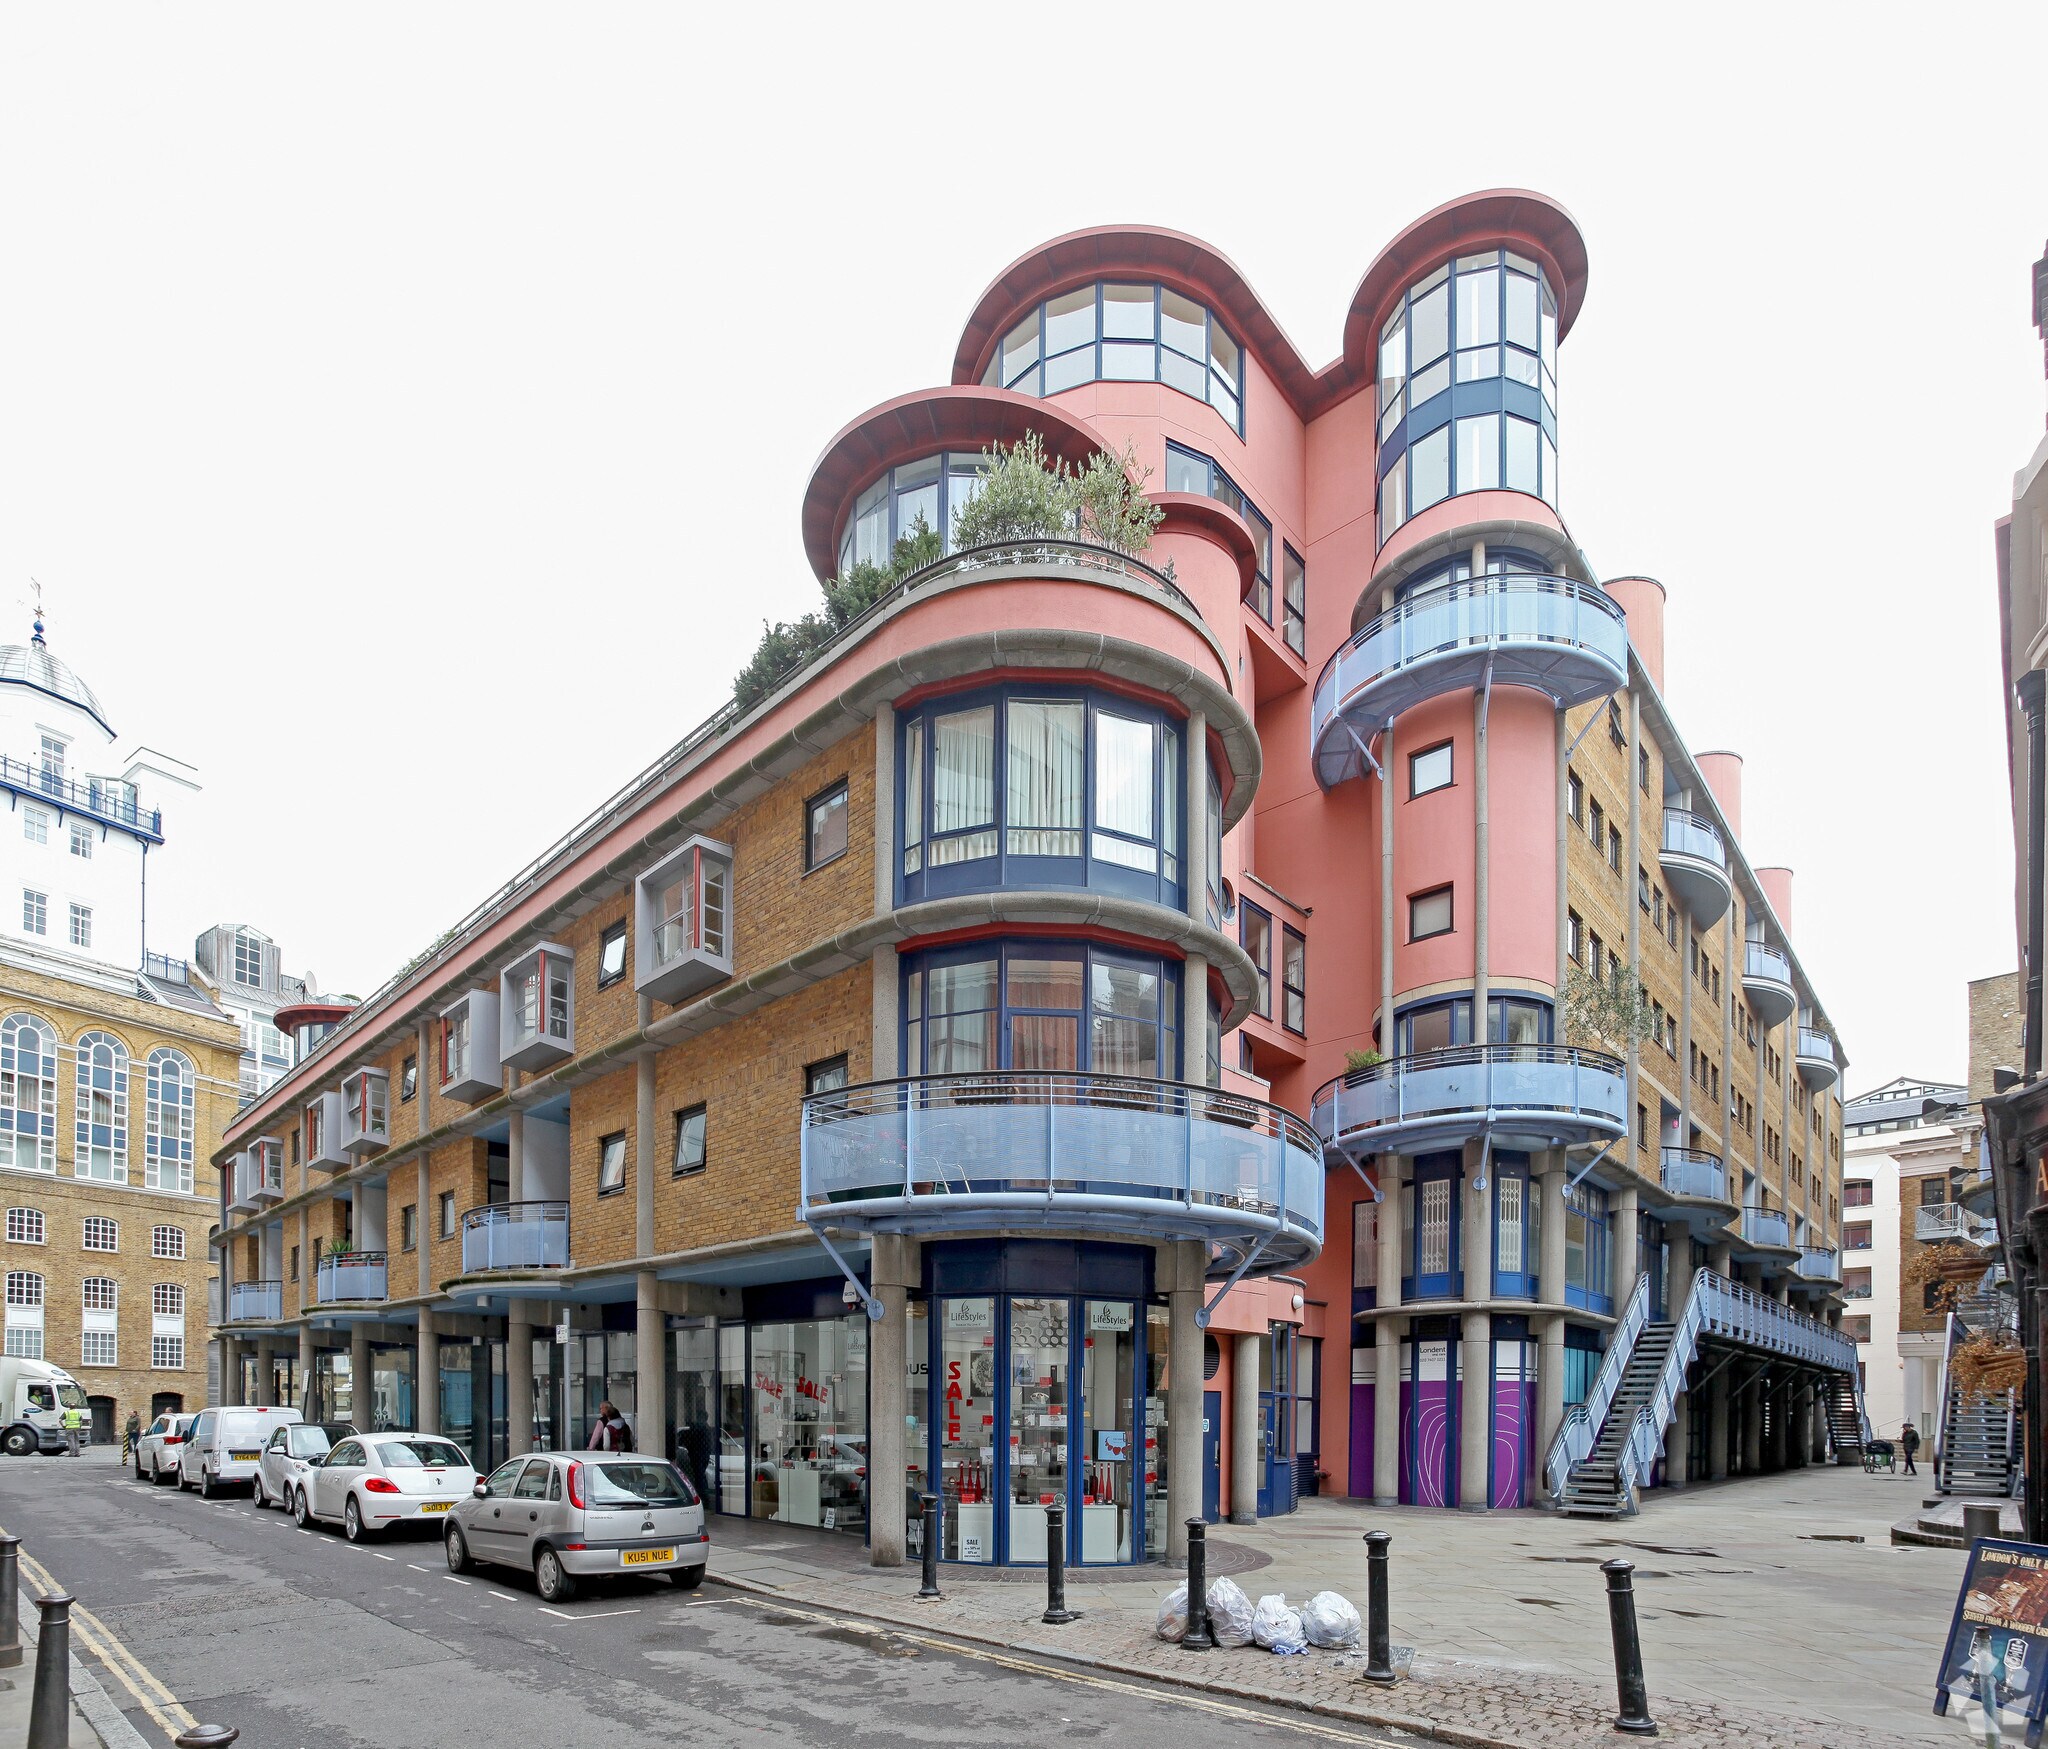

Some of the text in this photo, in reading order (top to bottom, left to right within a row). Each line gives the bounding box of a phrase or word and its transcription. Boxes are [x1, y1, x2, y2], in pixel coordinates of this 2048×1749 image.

[950, 1312, 987, 1322] LifeStyles
[1092, 1314, 1127, 1326] LifeStyles
[755, 1371, 783, 1400] SALE
[796, 1376, 828, 1404] SALE
[946, 1361, 963, 1441] SALE
[628, 1550, 669, 1562] KU51 NUE
[1981, 1550, 2019, 1565] LONDON'S
[2020, 1556, 2041, 1568] ONLY
[1963, 1610, 1985, 1622] SERVED
[2036, 1626, 2048, 1637] CAS
